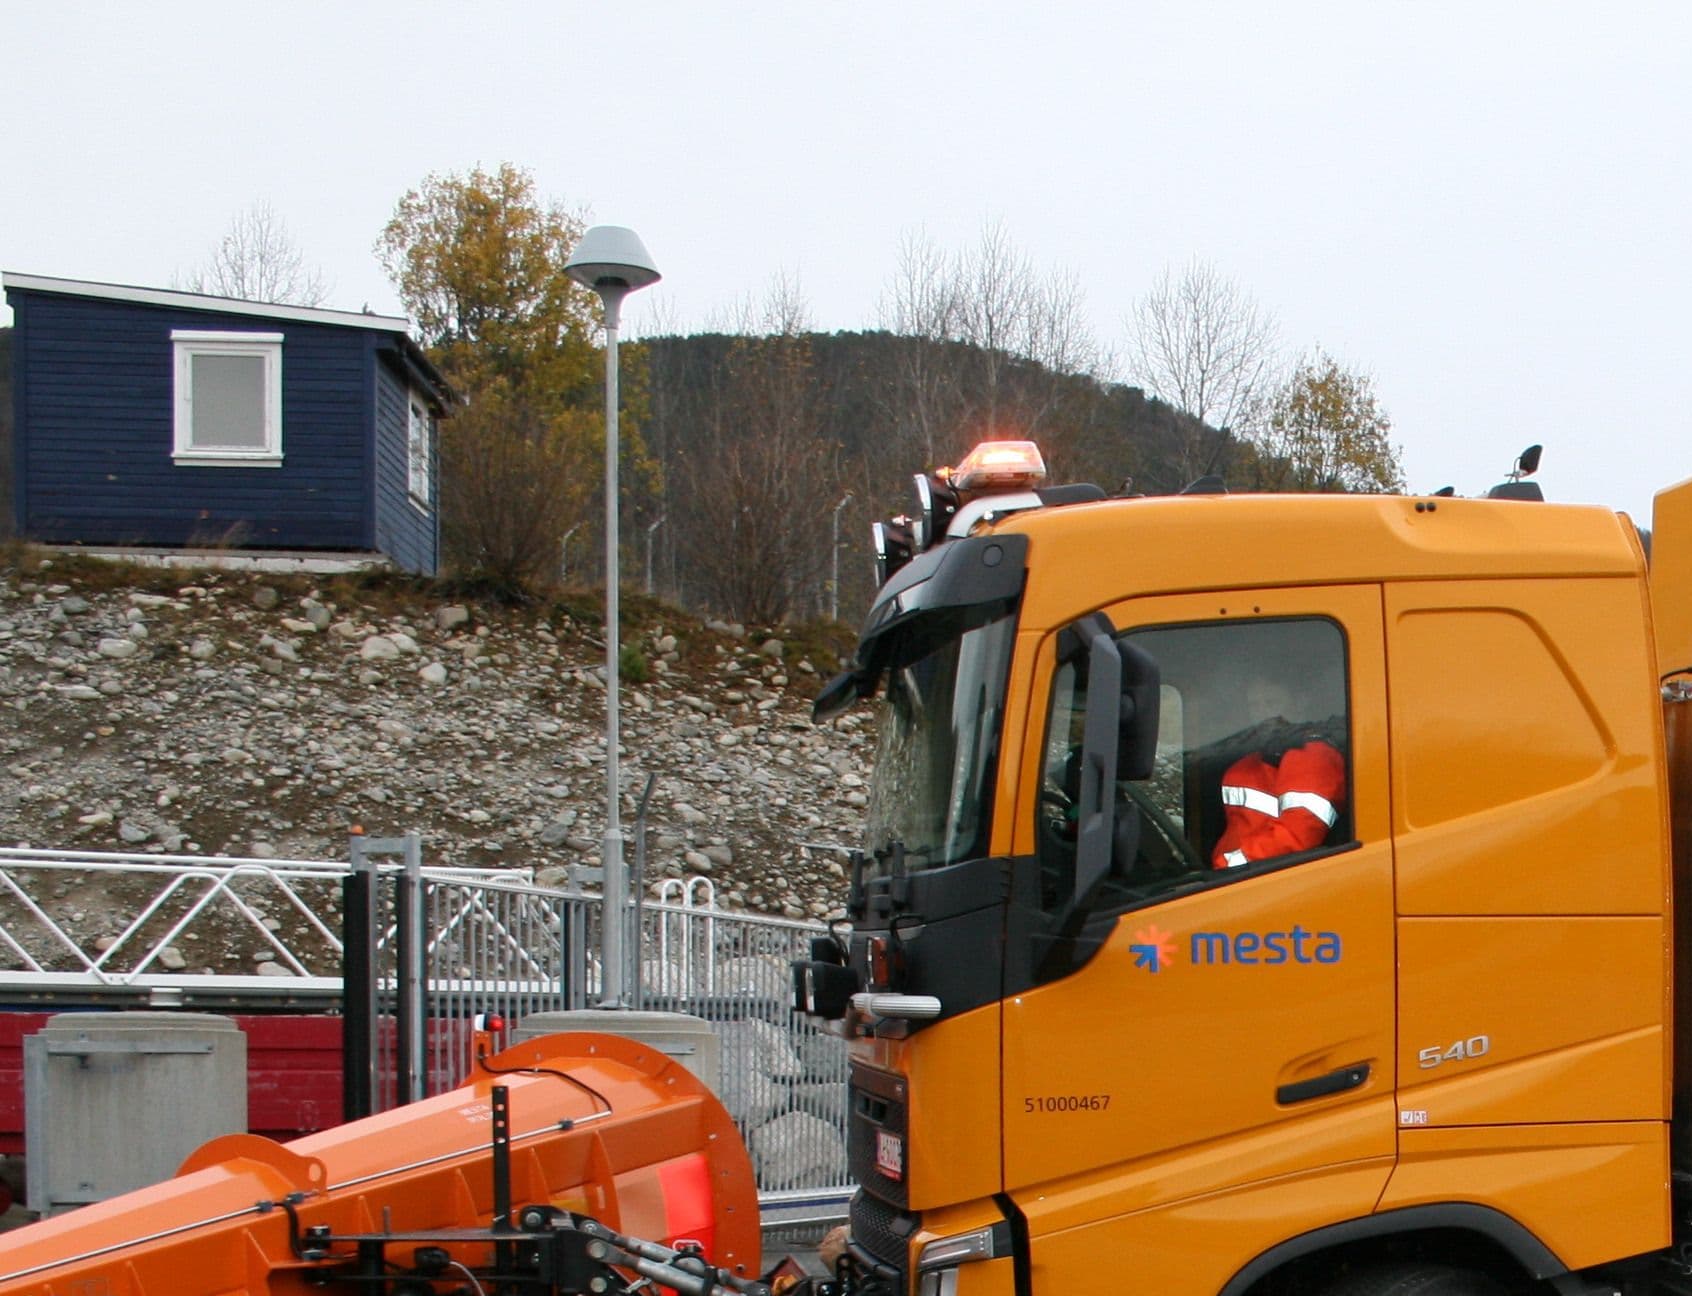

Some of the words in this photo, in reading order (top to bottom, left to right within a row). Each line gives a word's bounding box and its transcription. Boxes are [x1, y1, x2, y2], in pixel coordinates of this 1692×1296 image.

[1190, 925, 1342, 965] mesta
[1419, 1035, 1489, 1070] 540
[1024, 1095, 1111, 1113] 51000467
